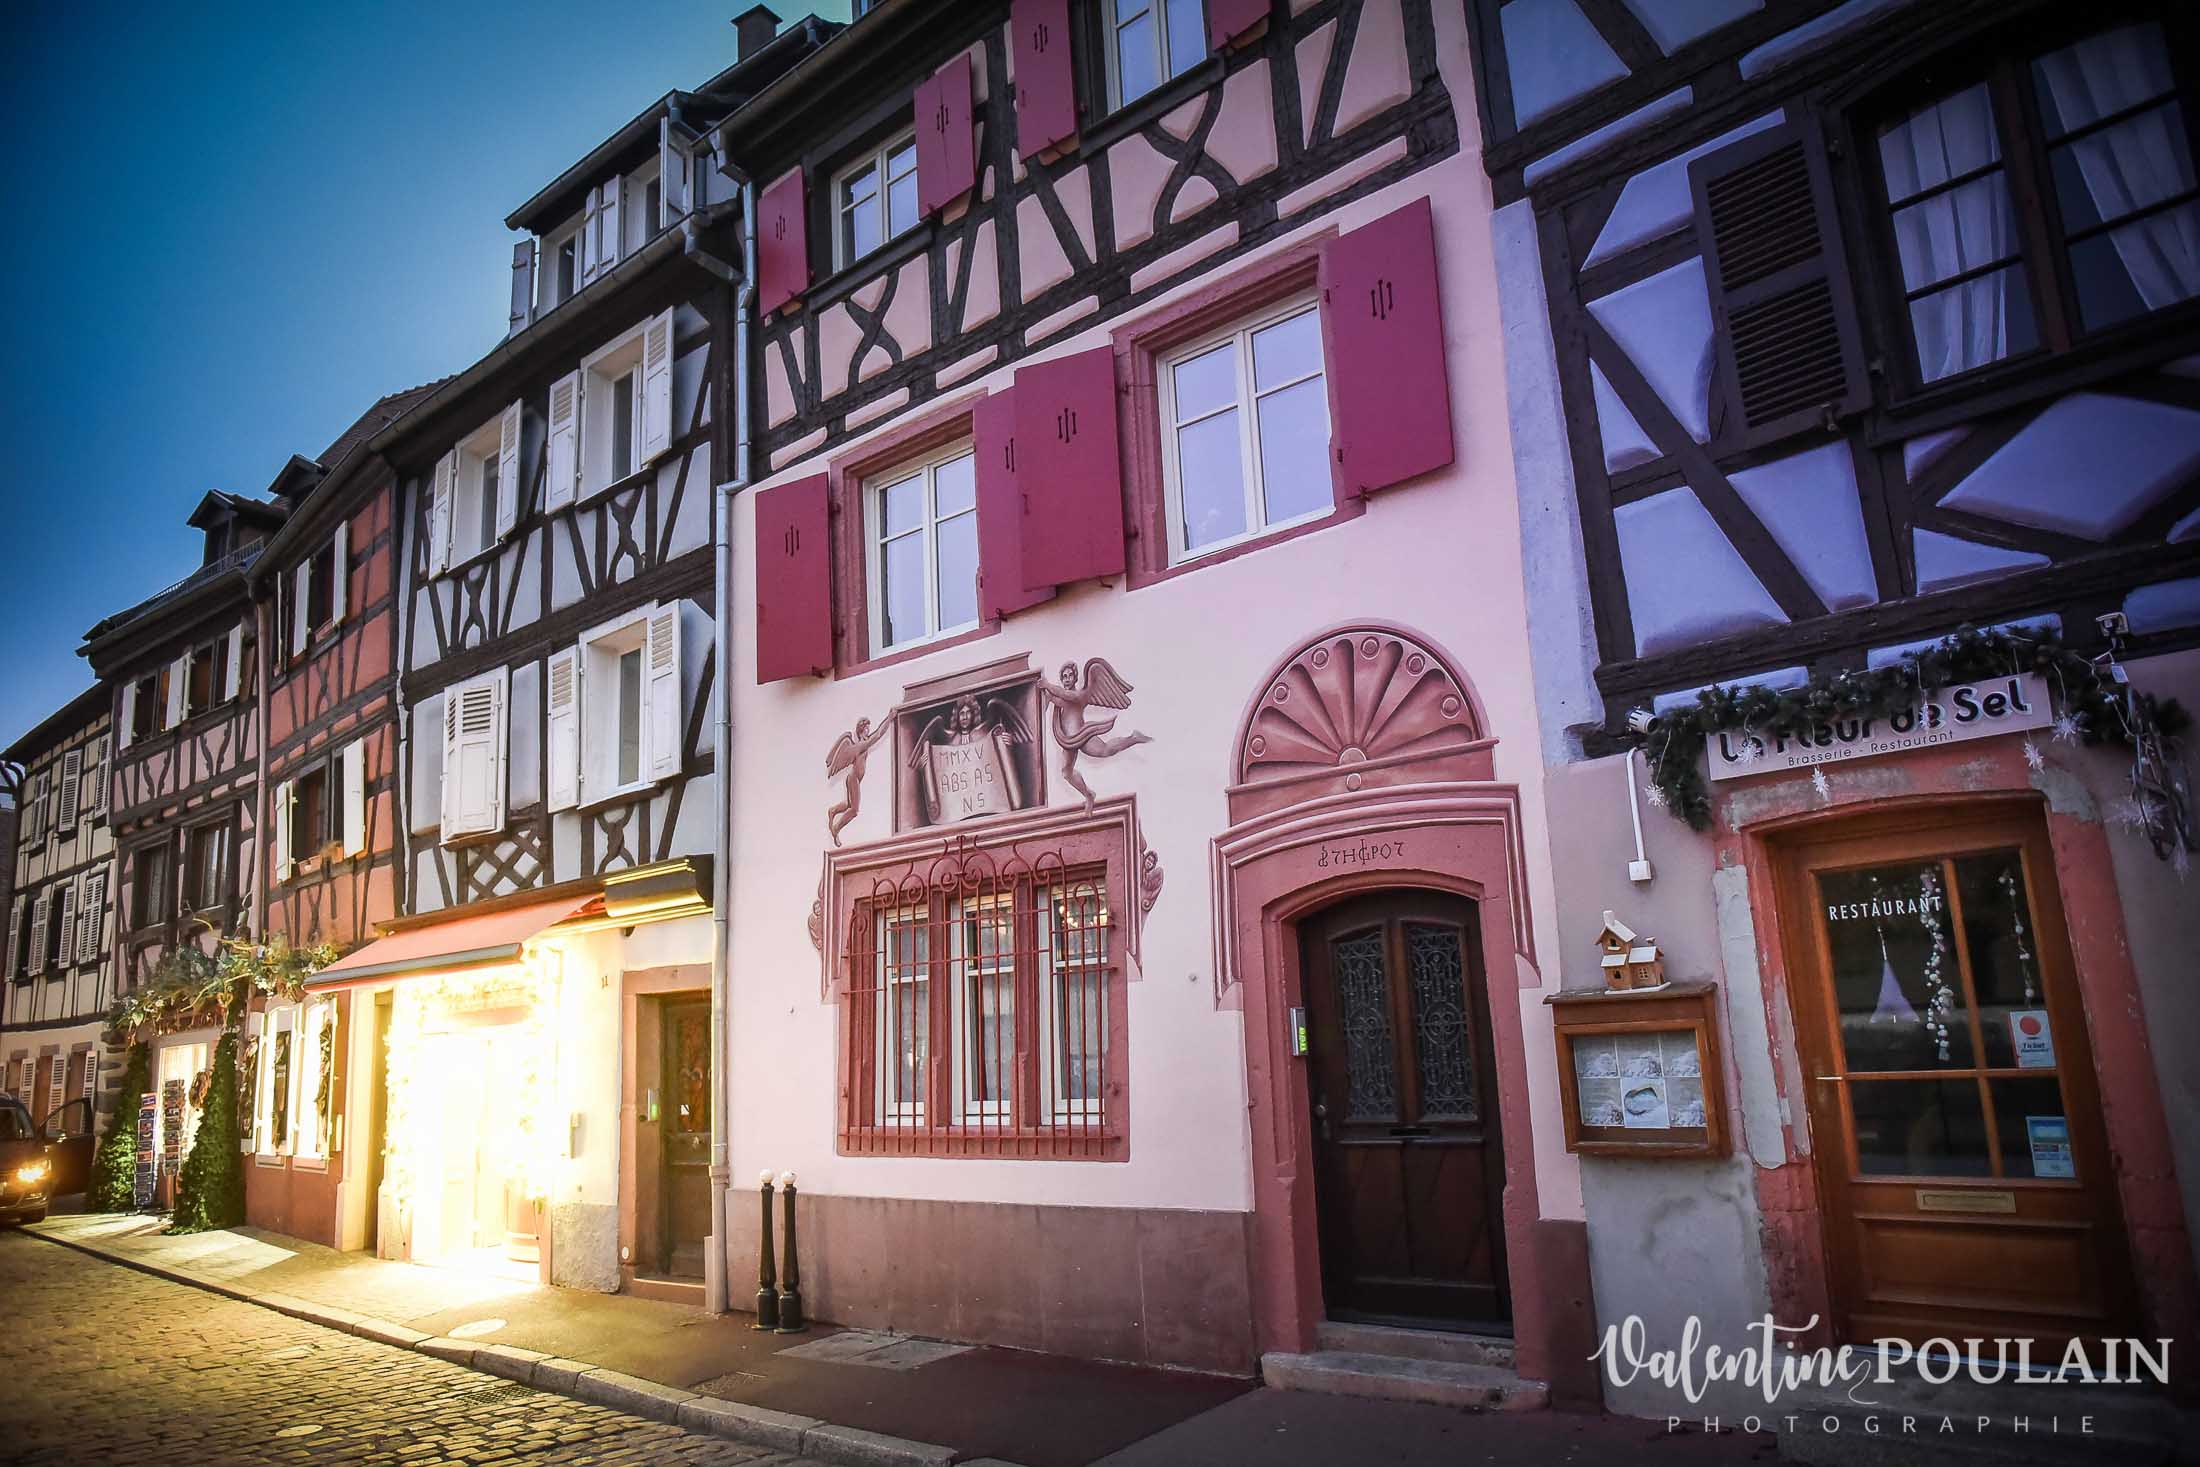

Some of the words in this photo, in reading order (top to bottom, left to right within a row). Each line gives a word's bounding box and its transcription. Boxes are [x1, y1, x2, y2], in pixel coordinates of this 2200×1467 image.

[1952, 679, 2029, 722] Sel
[1788, 749, 1852, 766] Brasserie
[1871, 730, 1953, 753] Restaurant
[1828, 897, 1941, 921] RESTAURANT
